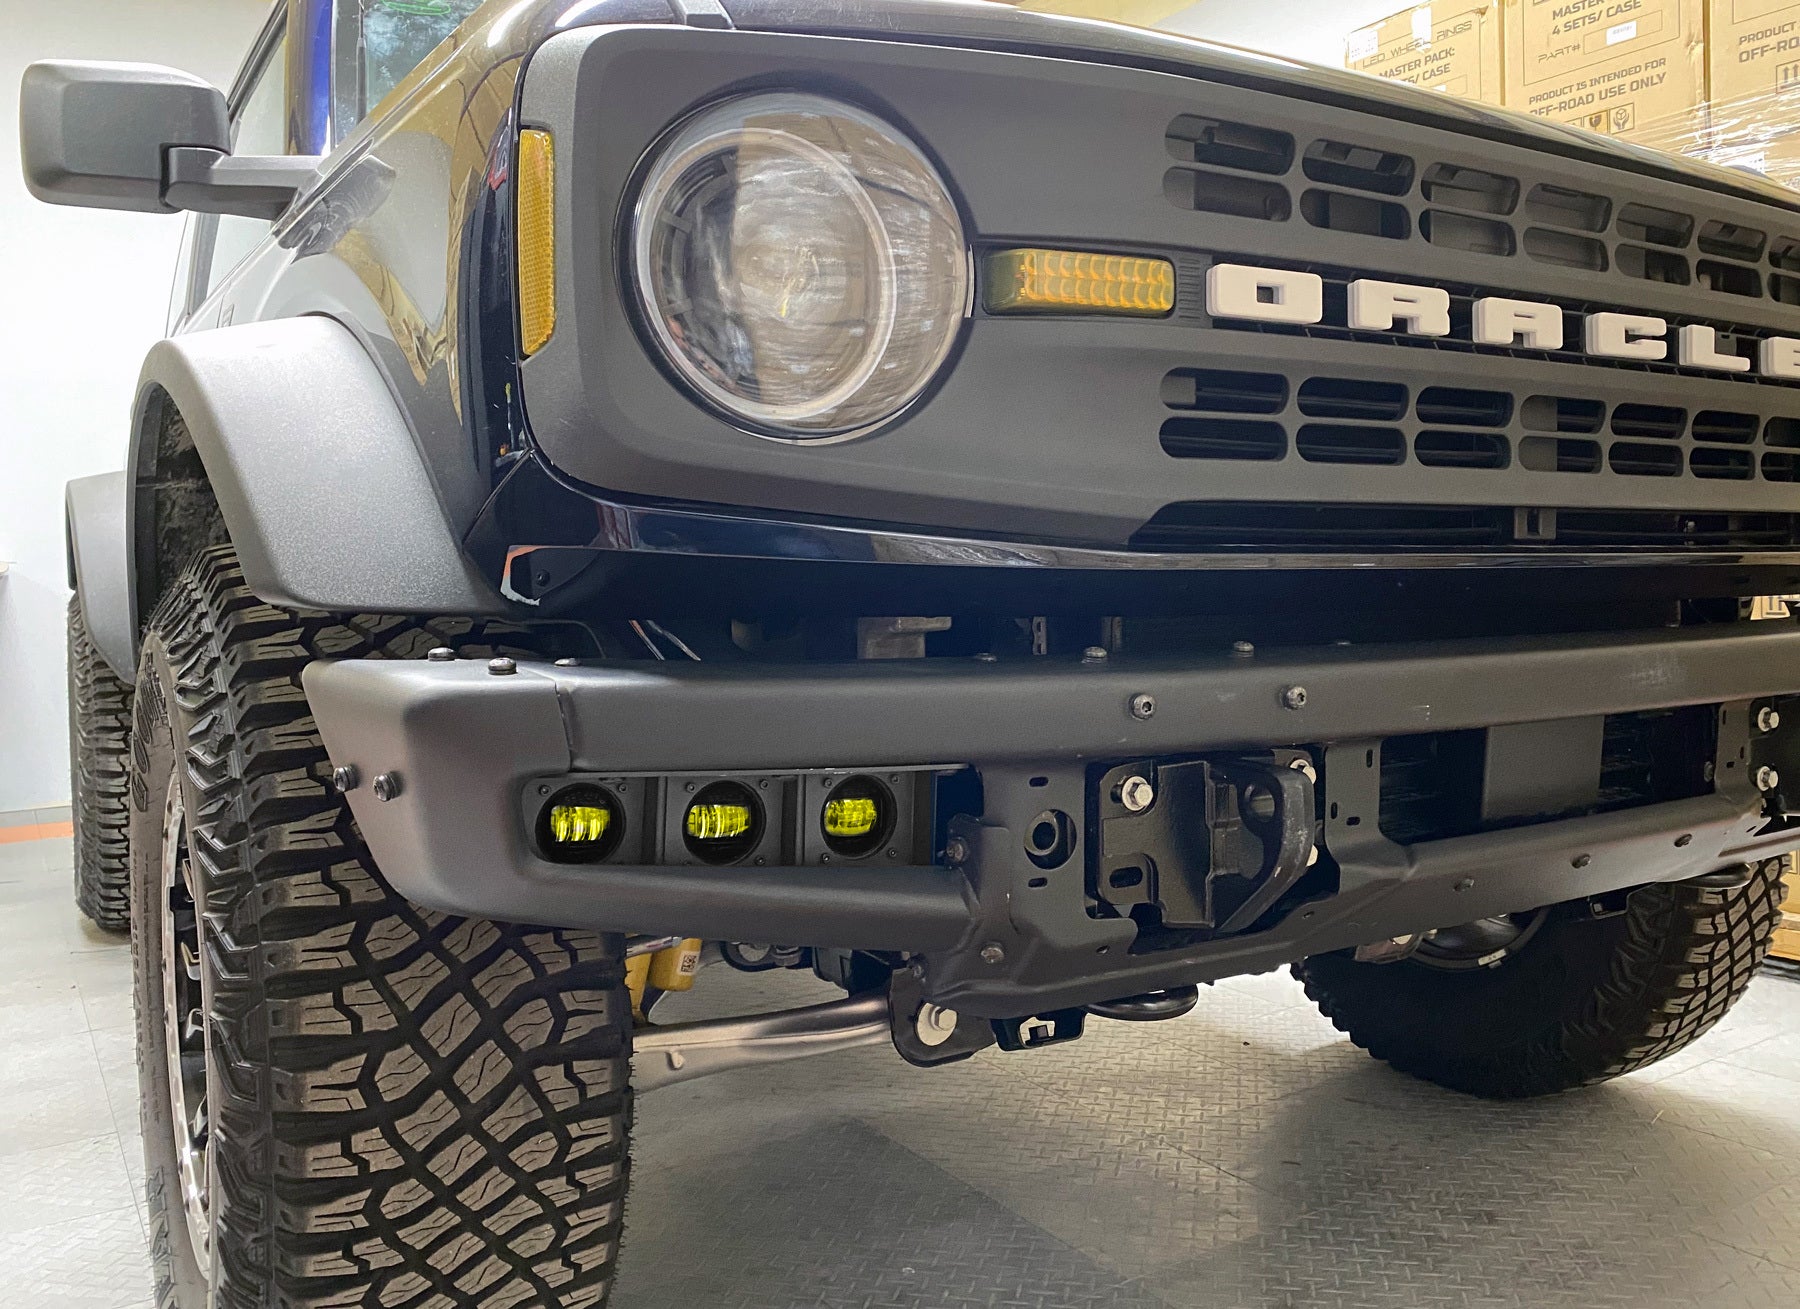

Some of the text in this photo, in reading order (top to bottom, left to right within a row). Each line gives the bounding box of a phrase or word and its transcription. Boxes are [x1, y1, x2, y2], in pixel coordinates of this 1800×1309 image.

[1552, 25, 1561, 36] 4
[1563, 10, 1603, 32] SETS/
[1606, 0, 1642, 18] CASE
[1362, 52, 1386, 69] LED
[1436, 20, 1473, 41] RINGS
[1739, 20, 1797, 46] PRODUCT
[1424, 46, 1456, 67] PACK:
[1537, 43, 1581, 64] PART#
[1422, 62, 1451, 81] CASE
[1528, 57, 1667, 105] PRODUCT IS INTENDED FOR
[1598, 83, 1627, 101] USE
[1629, 71, 1667, 93] ONLY
